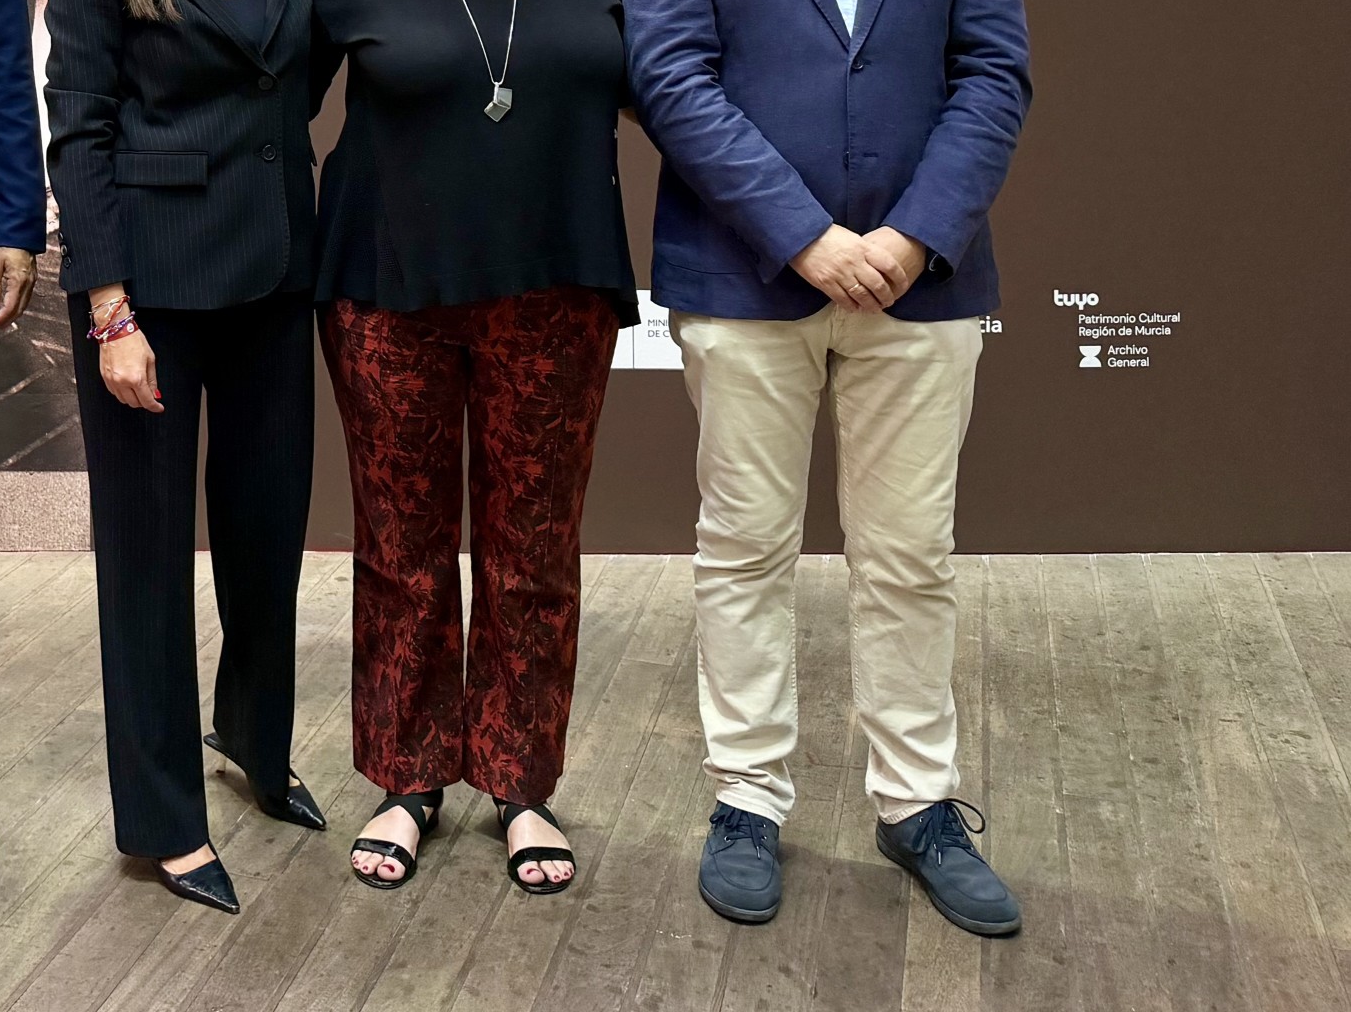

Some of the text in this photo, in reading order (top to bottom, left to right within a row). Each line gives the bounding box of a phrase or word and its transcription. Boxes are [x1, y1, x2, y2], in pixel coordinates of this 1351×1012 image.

[1053, 289, 1100, 311] tuyo
[1078, 312, 1181, 325] Patrimonio Cultural
[647, 329, 661, 338] DE
[1078, 324, 1172, 340] Región de Murcia
[1107, 344, 1149, 355] Archivo
[1107, 356, 1150, 368] General
